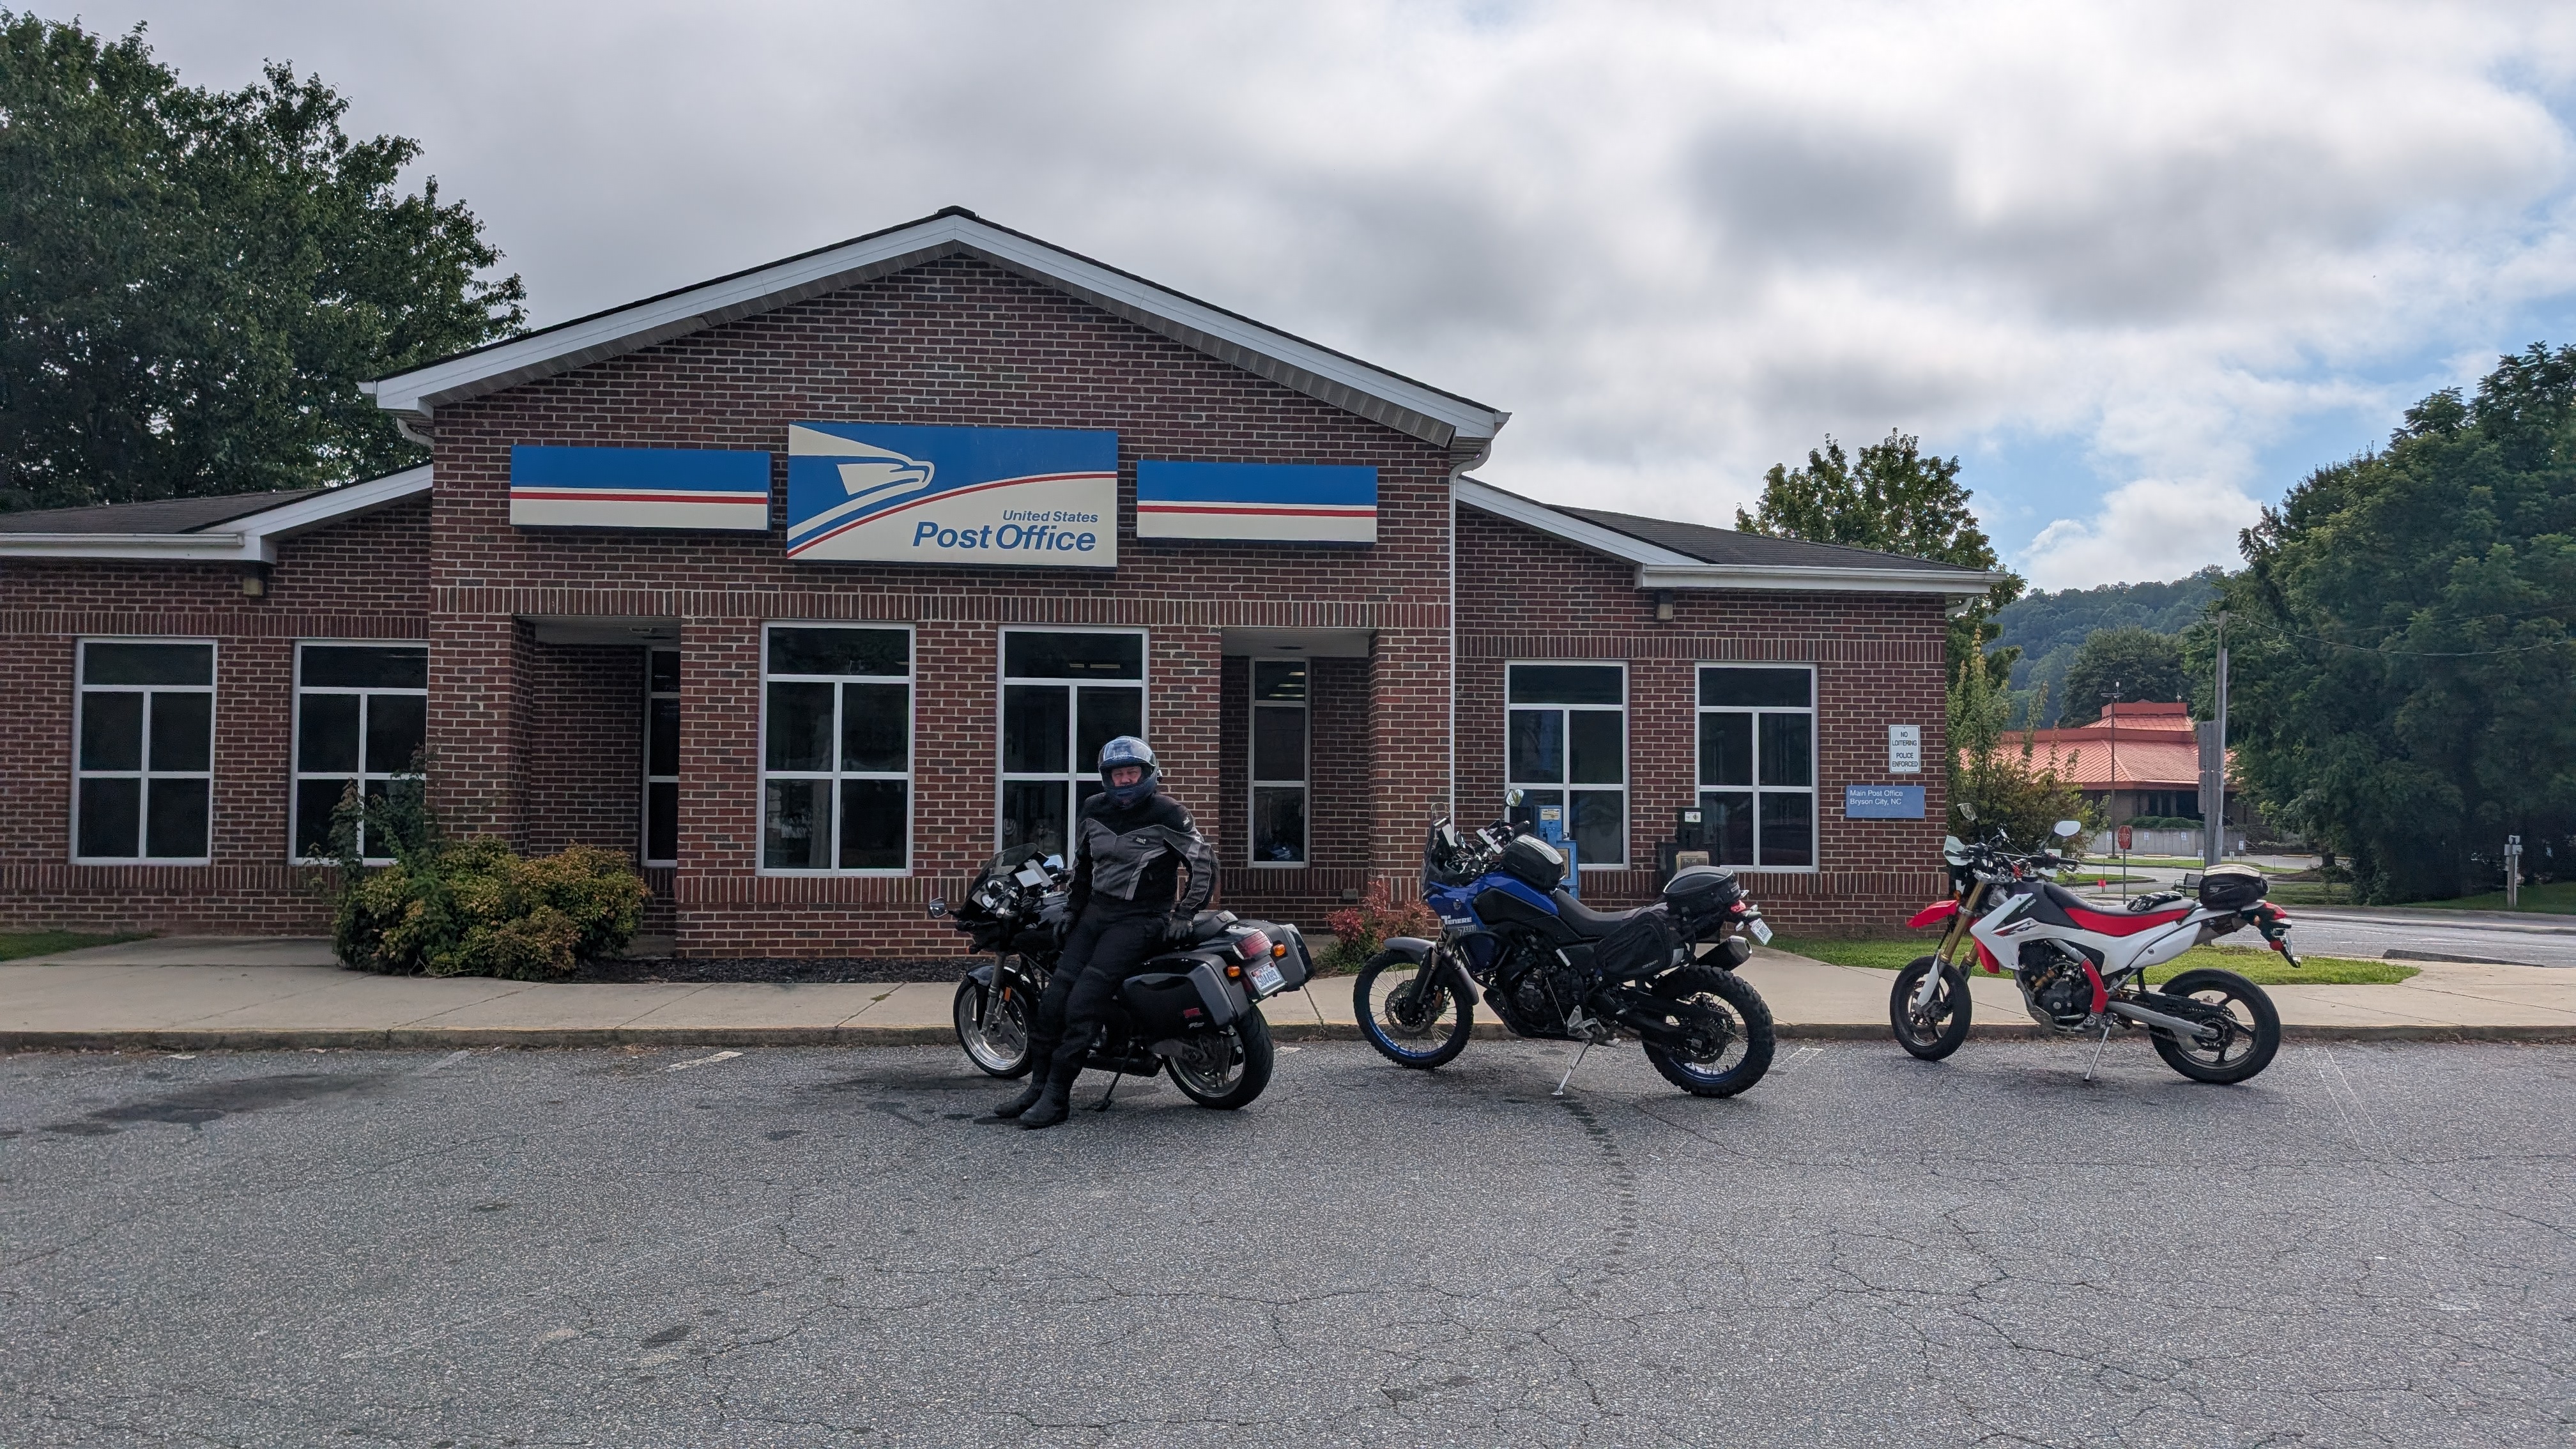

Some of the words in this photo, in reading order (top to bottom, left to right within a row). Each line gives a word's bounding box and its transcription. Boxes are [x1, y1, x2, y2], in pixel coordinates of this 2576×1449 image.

[1002, 510, 1050, 522] United
[1052, 510, 1098, 523] States
[912, 521, 992, 549] Post
[995, 524, 1096, 551] Office
[1850, 798, 1873, 806] Bryson
[1874, 798, 1889, 806] City,
[2118, 832, 2130, 842] STOP
